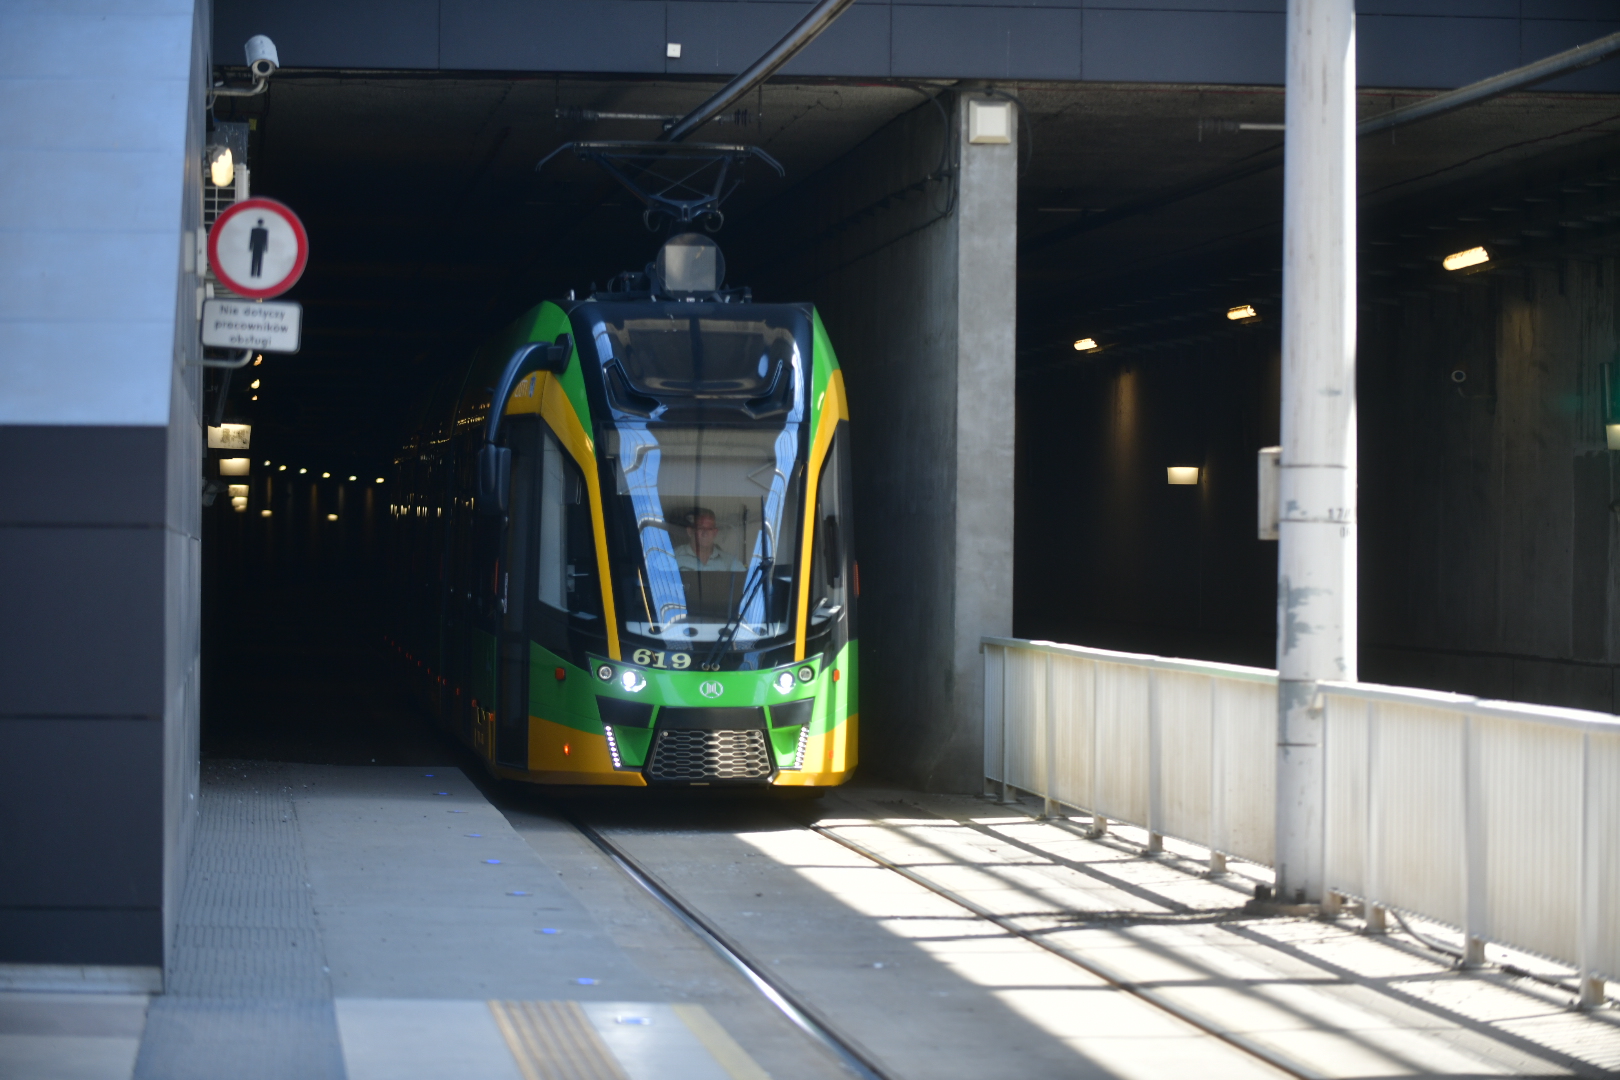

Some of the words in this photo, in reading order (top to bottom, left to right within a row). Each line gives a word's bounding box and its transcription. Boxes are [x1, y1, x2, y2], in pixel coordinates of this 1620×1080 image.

[220, 305, 238, 315] Nie
[243, 306, 285, 320] dotyczy
[633, 649, 692, 669] 619
